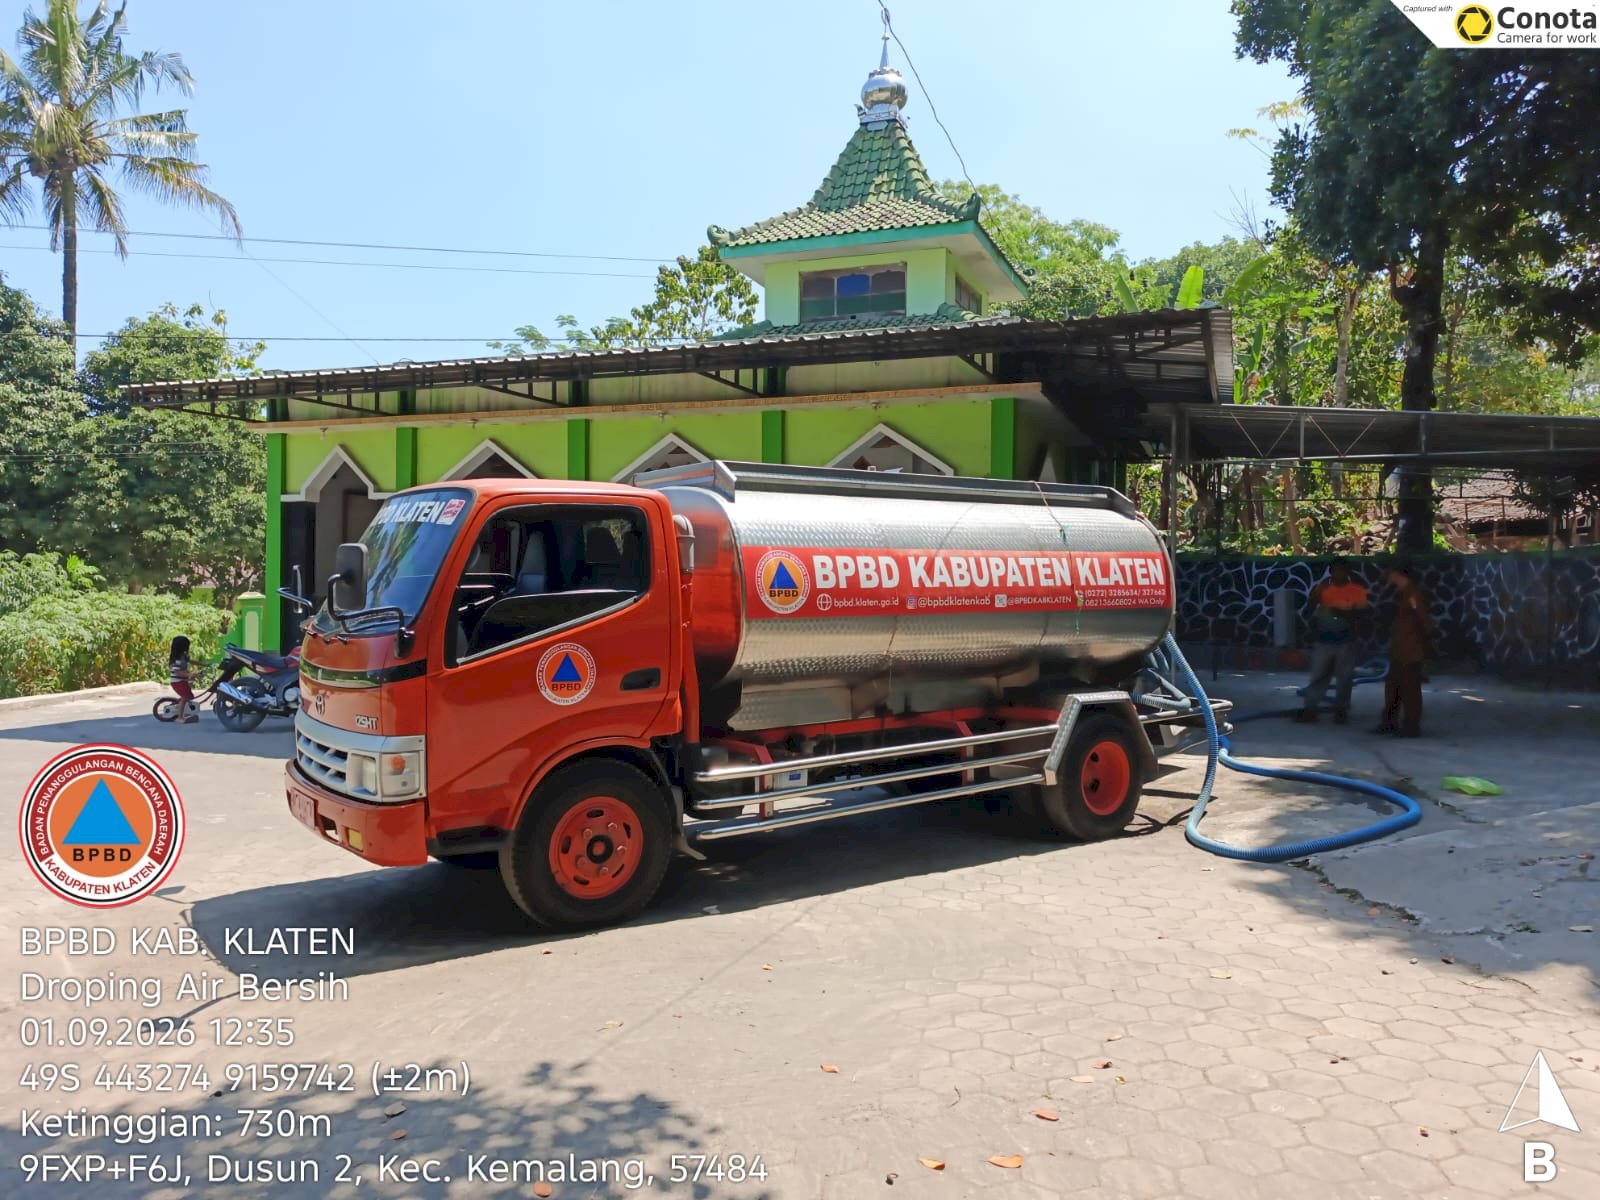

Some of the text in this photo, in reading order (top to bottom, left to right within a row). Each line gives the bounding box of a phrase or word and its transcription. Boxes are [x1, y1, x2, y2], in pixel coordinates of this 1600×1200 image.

[391, 501, 445, 523] KLATEN
[812, 555, 900, 589] BPBD
[908, 556, 1072, 588] KABUPATEN
[1075, 557, 1165, 586] KLATEN
[918, 596, 991, 609] @bpbdklatenkab
[552, 683, 581, 691] BPBD
